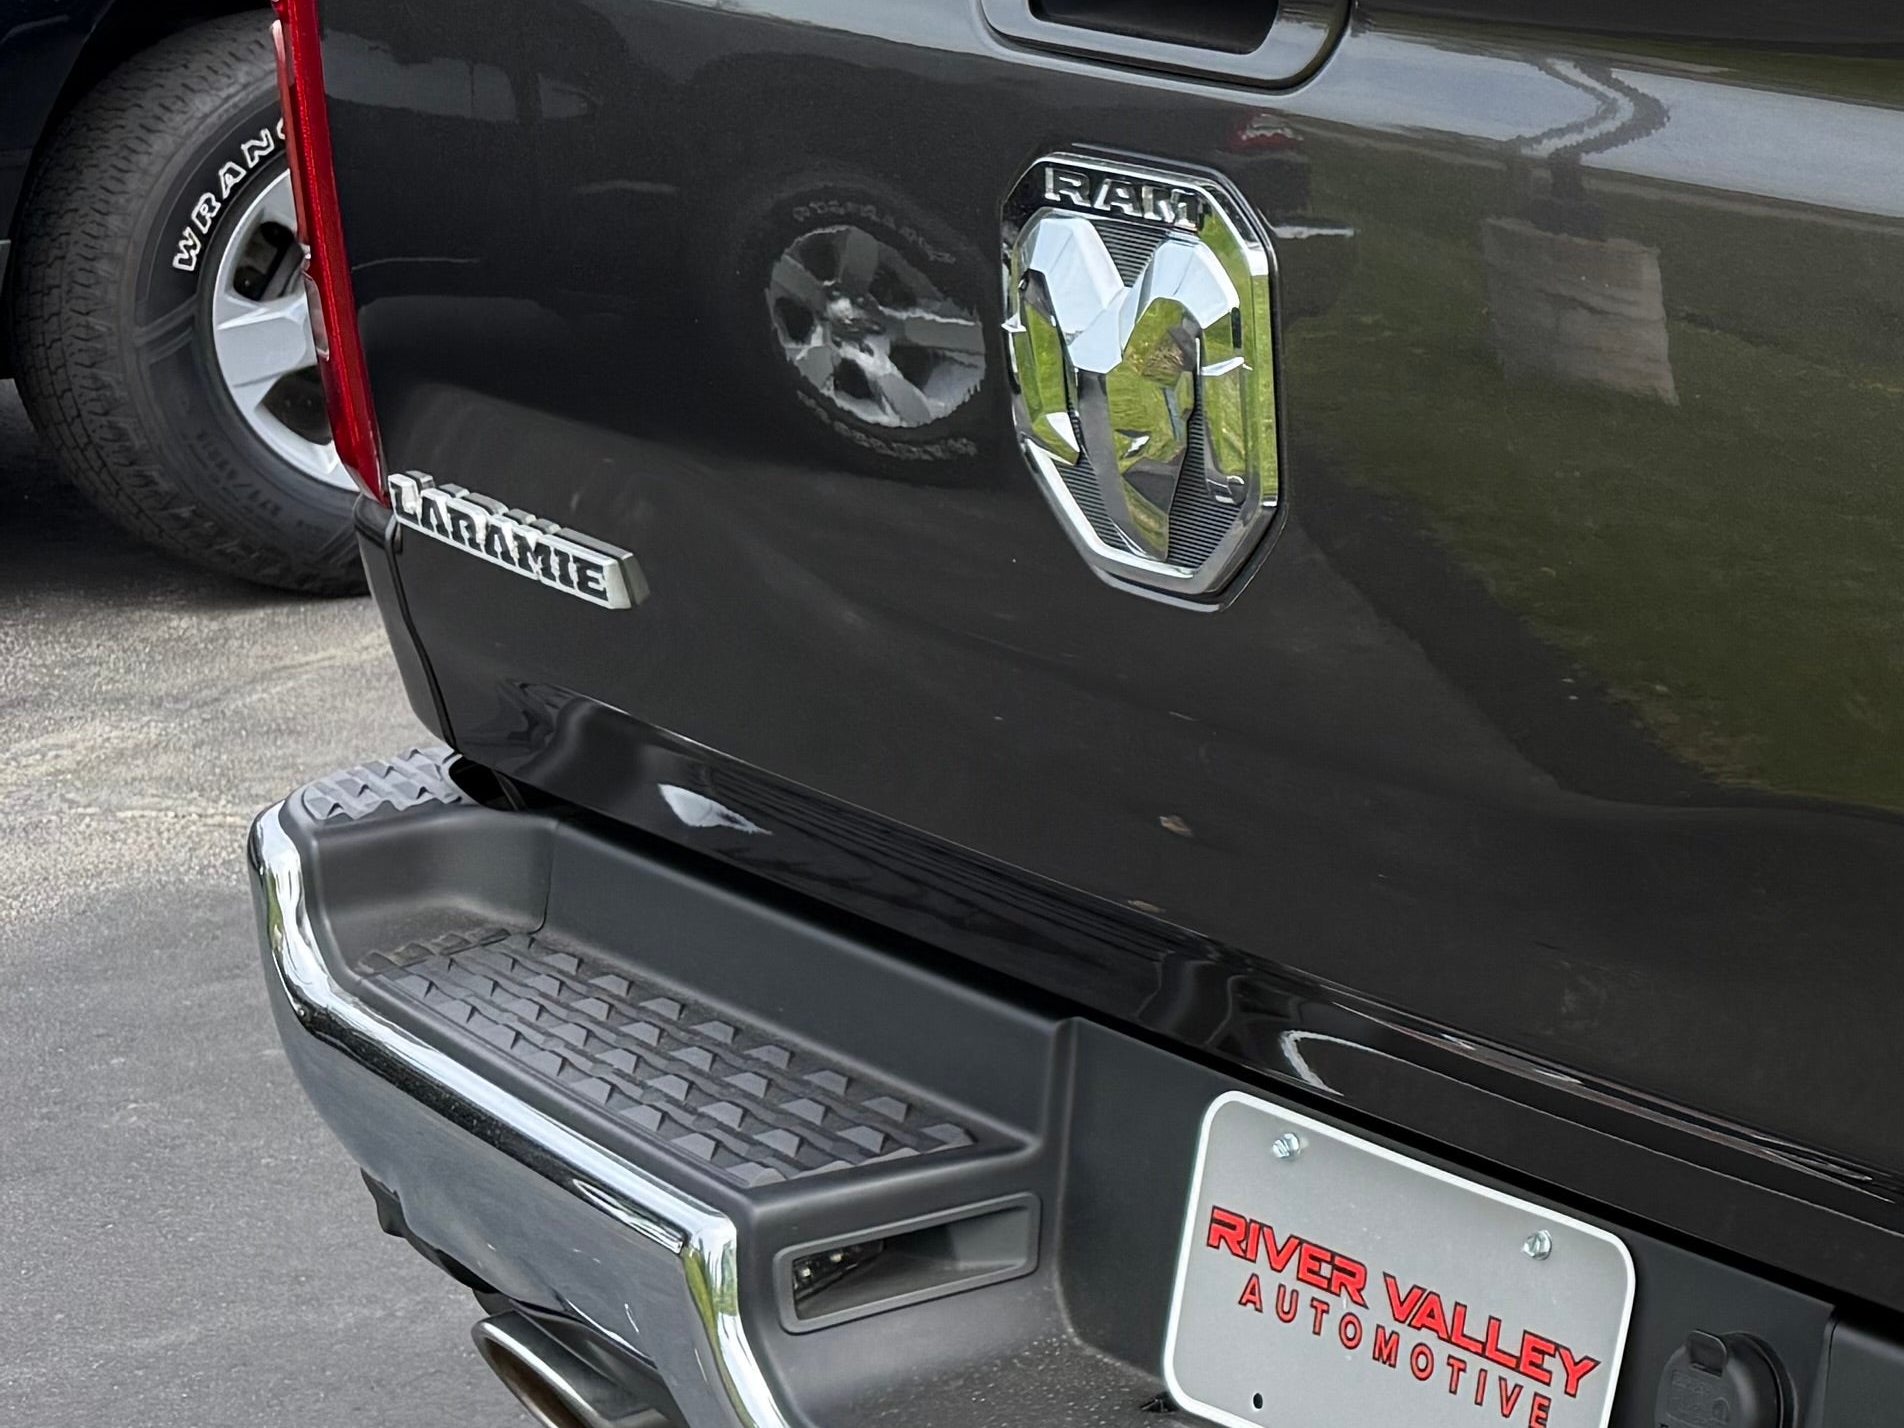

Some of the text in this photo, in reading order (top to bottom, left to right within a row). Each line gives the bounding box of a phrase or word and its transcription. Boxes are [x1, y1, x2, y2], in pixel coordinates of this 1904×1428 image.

[1044, 166, 1203, 231] RAM
[388, 470, 634, 610] LARAMIE
[1206, 1205, 1602, 1399] RIVER VALLEY
